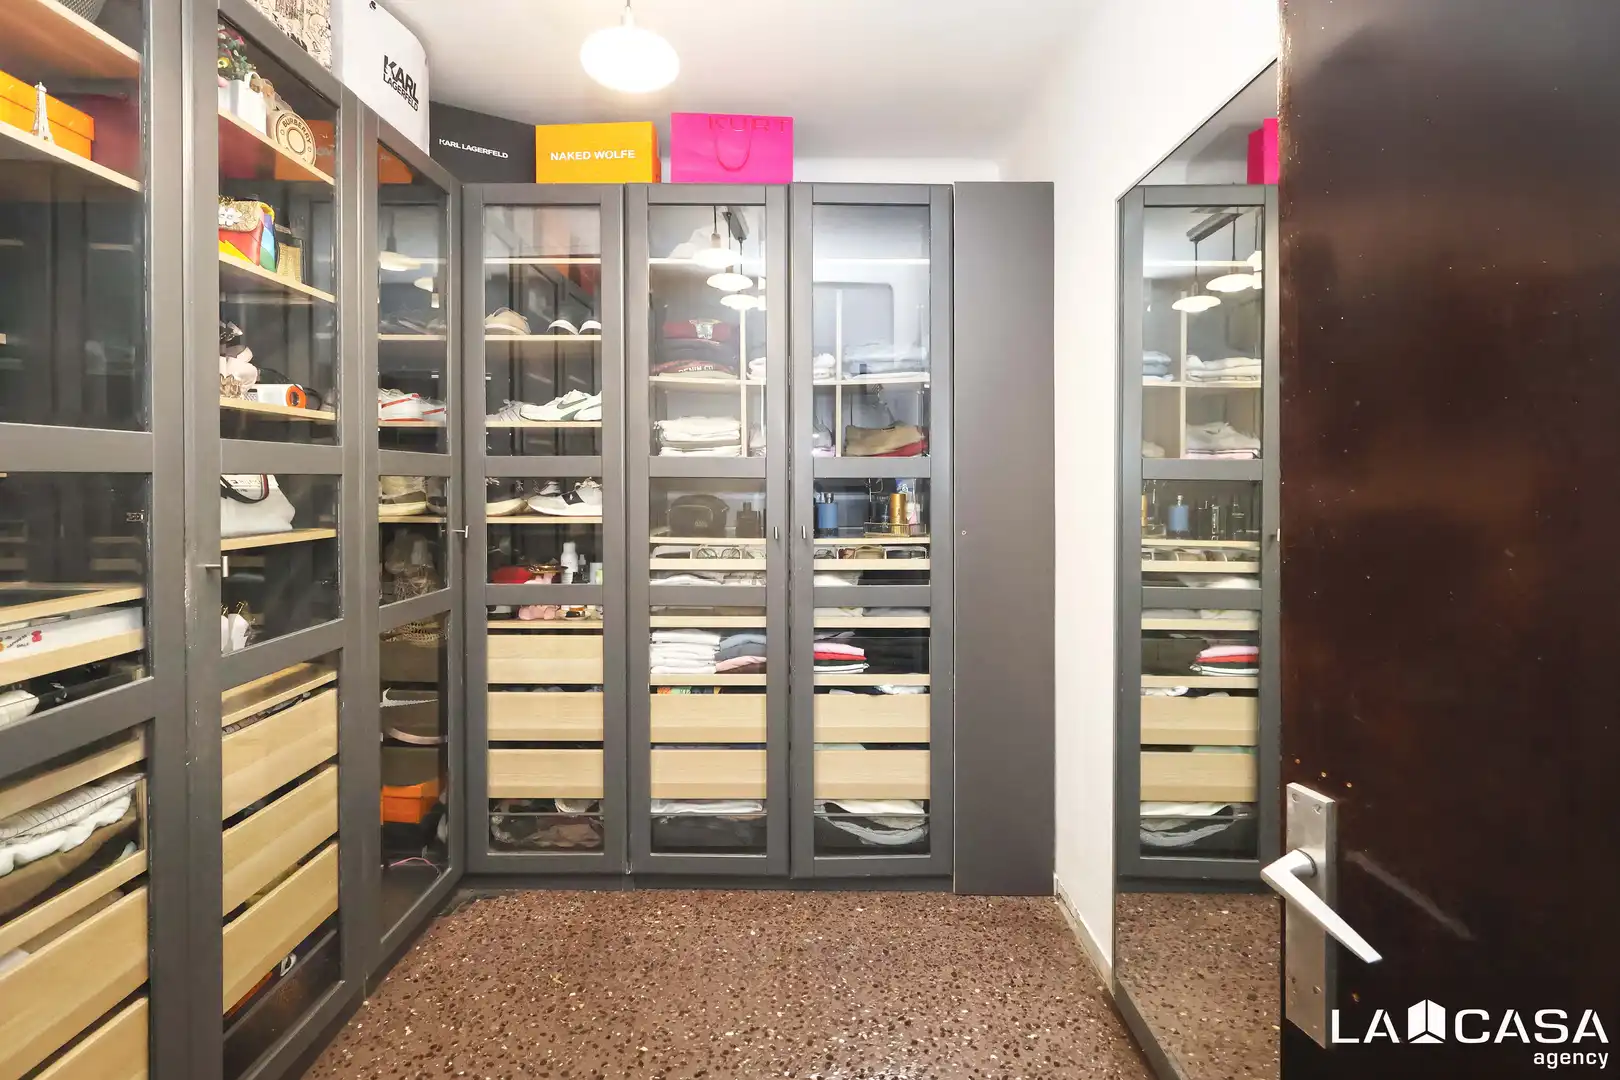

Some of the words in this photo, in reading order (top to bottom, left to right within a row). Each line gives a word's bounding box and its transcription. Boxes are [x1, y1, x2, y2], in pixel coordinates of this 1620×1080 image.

[383, 54, 419, 105] KARL
[383, 73, 419, 112] LAGERFELD
[281, 117, 312, 145] BURBERRY
[708, 115, 789, 132] KURT
[438, 138, 461, 149] KARL
[461, 143, 509, 159] LAGERFELD
[550, 151, 592, 161] NAKED
[594, 149, 636, 160] WOLFE
